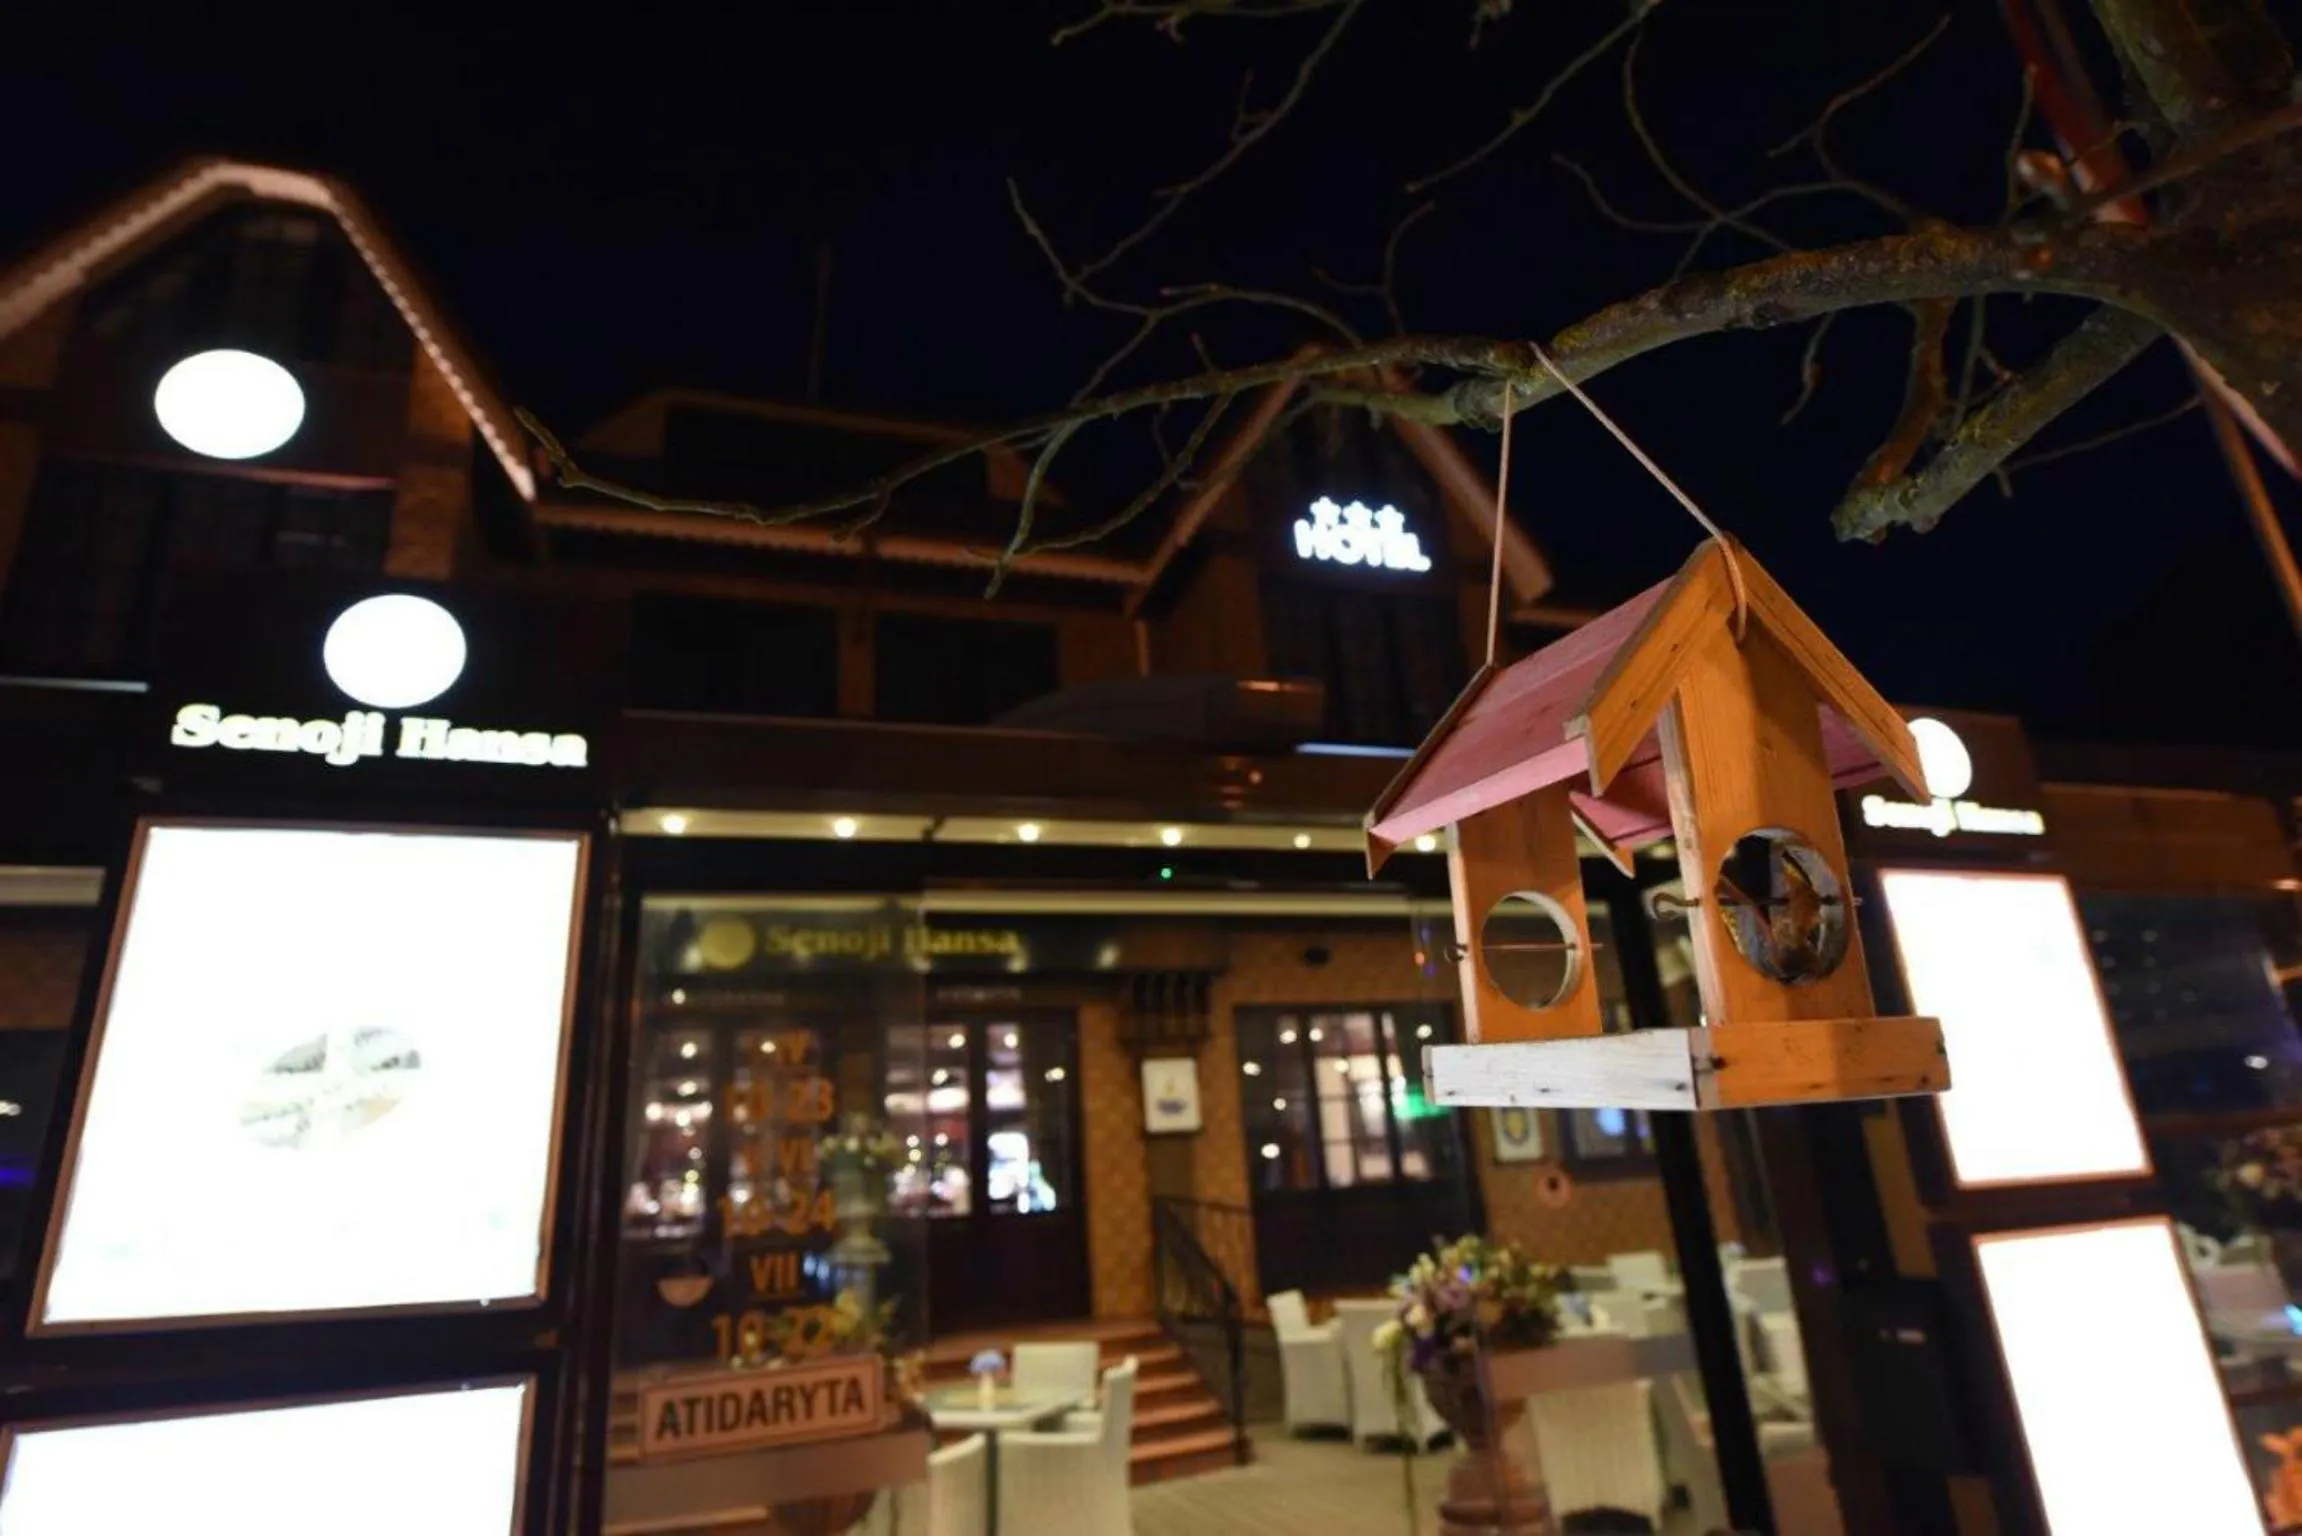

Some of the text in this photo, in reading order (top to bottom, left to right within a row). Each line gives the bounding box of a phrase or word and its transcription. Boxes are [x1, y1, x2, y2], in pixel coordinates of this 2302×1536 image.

[173, 705, 587, 766] Senoji Hansa
[766, 926, 890, 961] Senoji
[750, 1252, 798, 1293] VII
[655, 1376, 866, 1440] ATIDARYTA
